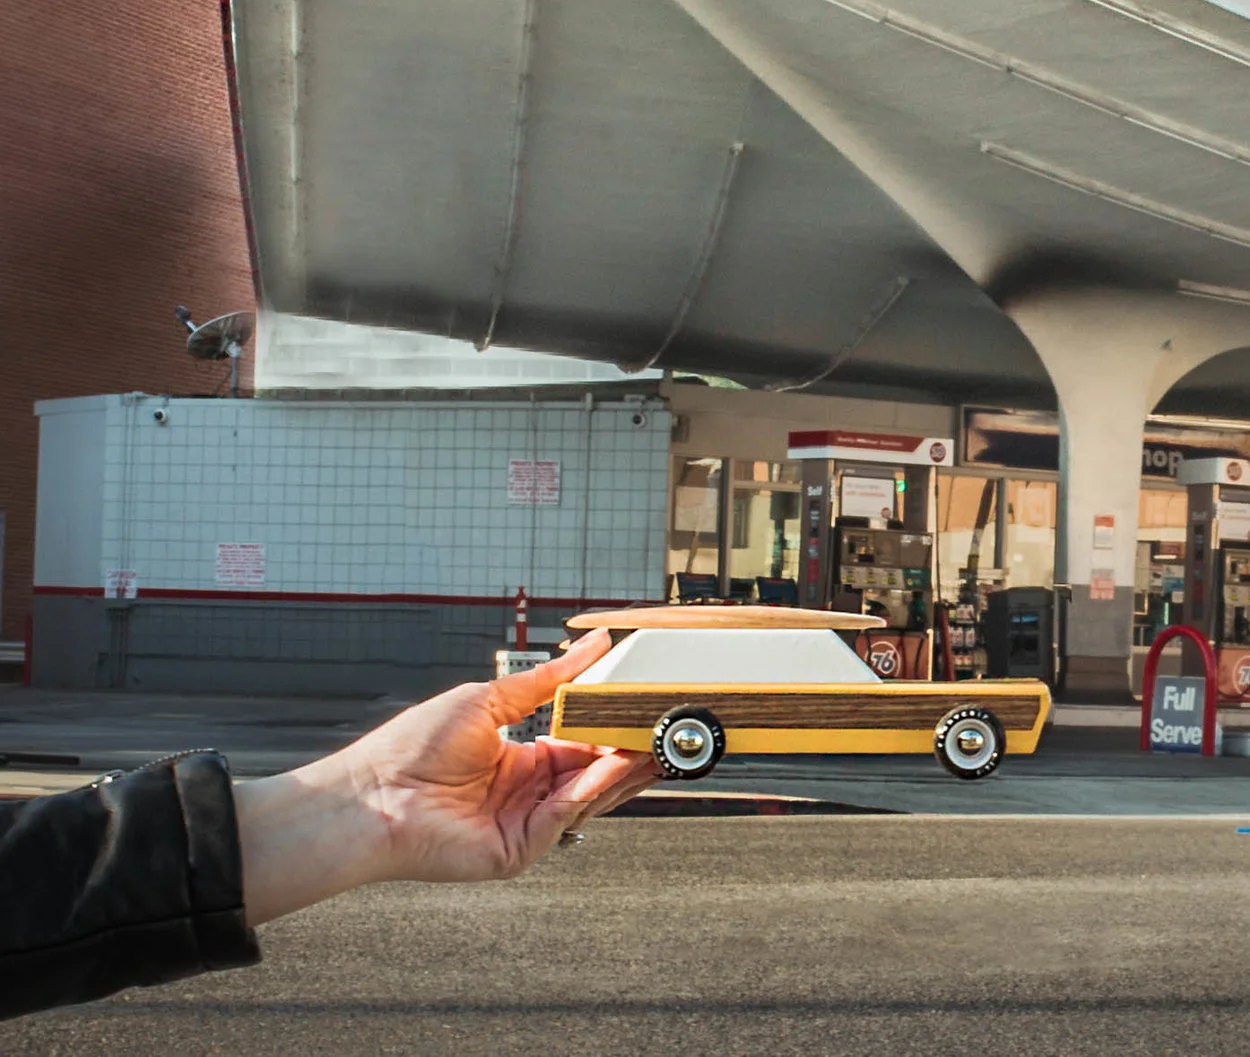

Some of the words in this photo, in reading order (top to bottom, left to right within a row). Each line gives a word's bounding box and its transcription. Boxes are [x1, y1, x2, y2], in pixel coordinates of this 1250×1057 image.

[807, 486, 822, 496] Self
[870, 649, 896, 674] 76
[1163, 685, 1196, 711] Full
[1151, 718, 1202, 745] Serve
